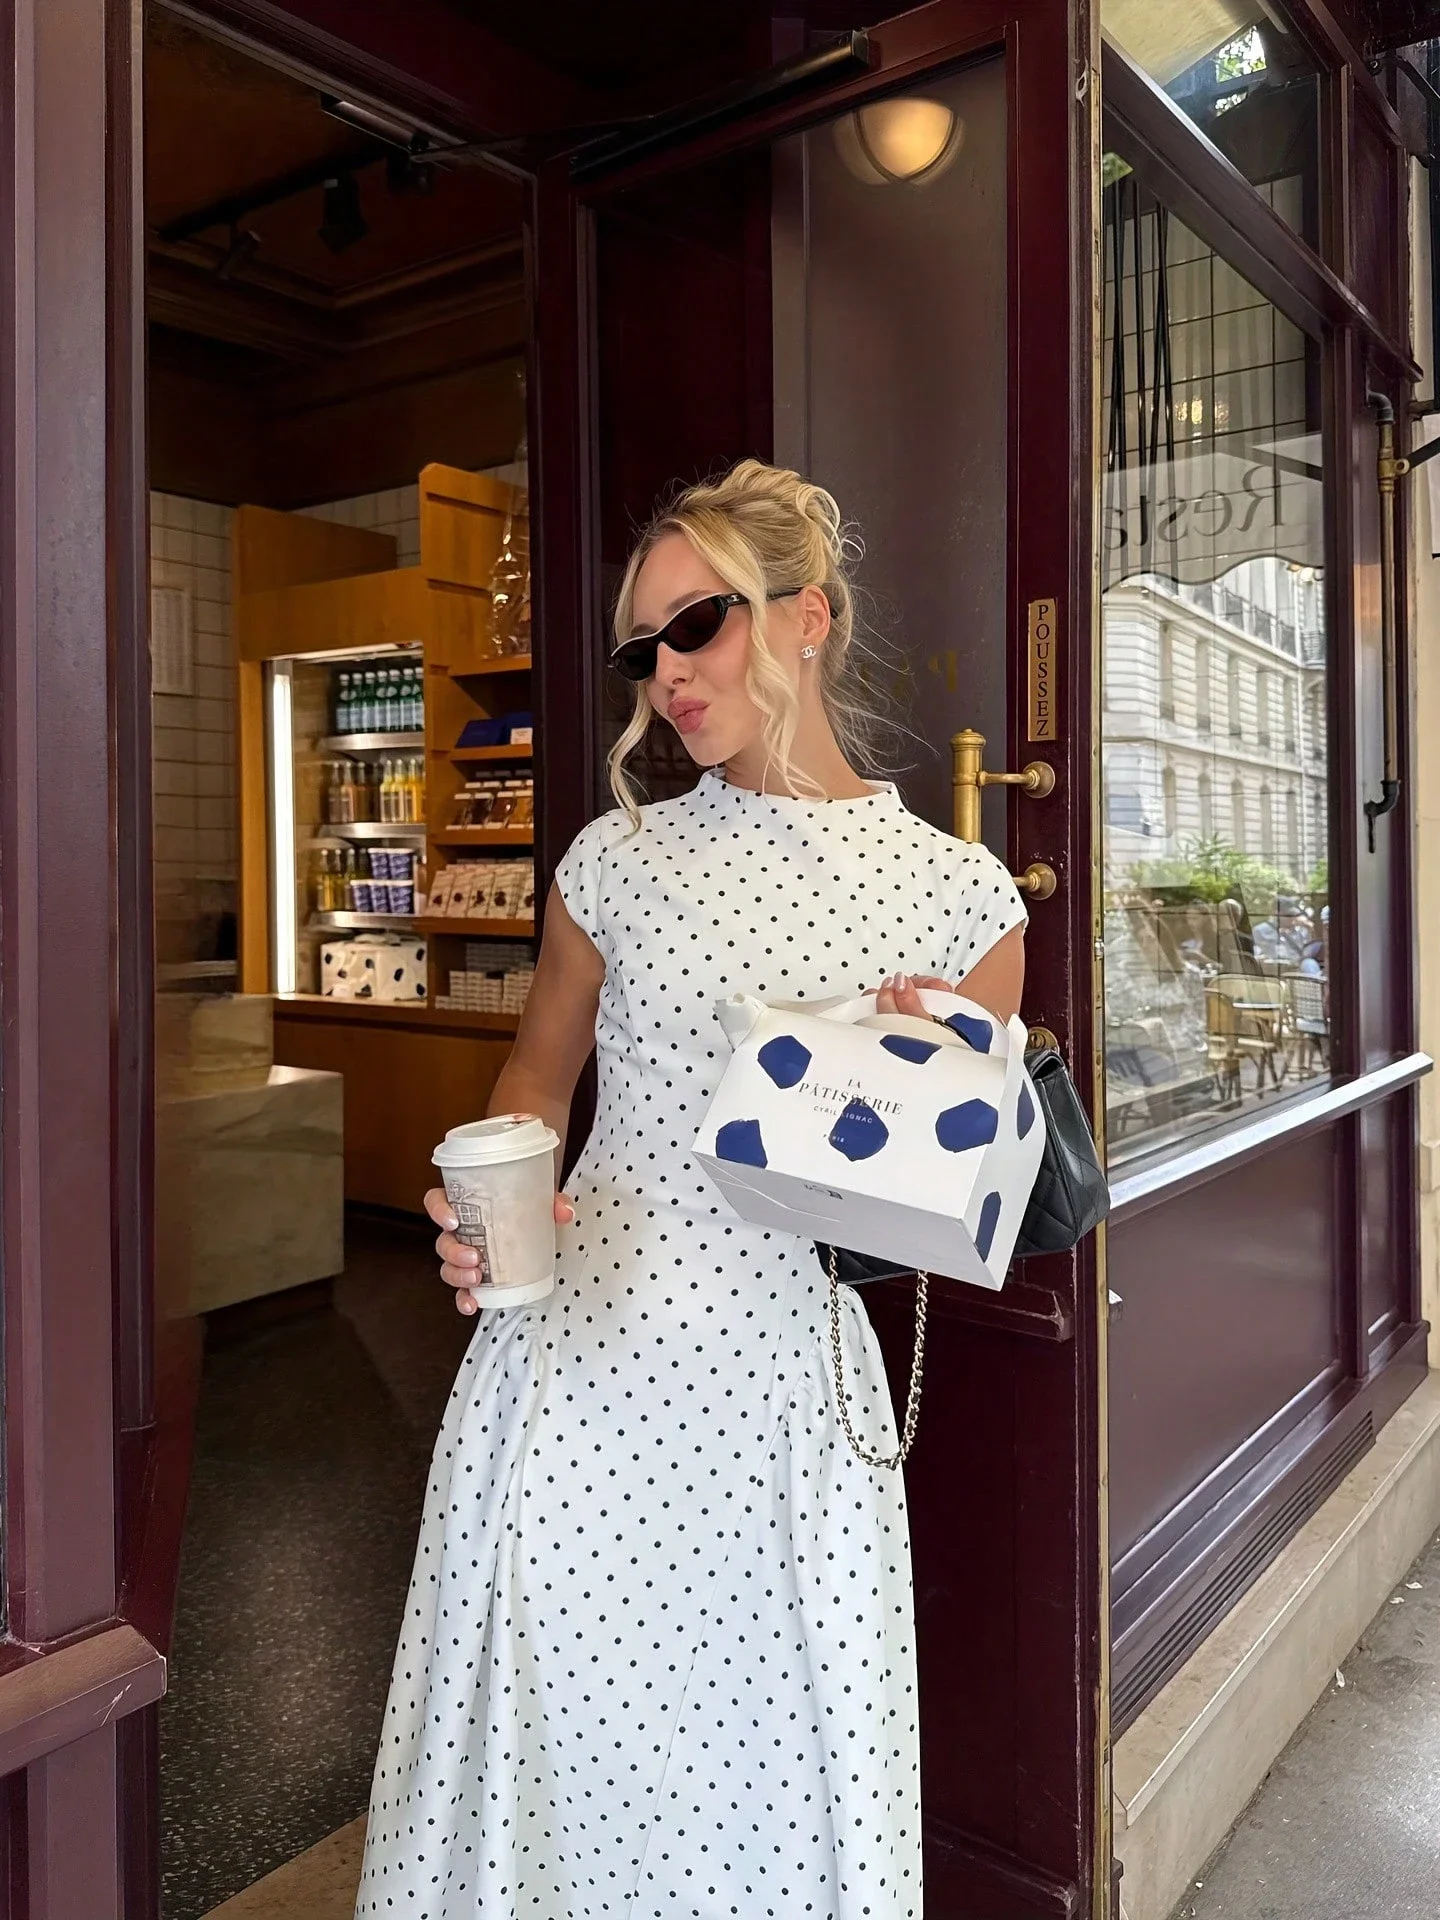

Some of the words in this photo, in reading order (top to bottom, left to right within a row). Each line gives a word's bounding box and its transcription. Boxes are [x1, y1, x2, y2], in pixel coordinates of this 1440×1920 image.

[1036, 604, 1050, 737] POUSSEZ
[848, 1079, 861, 1088] LA
[813, 1105, 837, 1116] CYRIL
[841, 1111, 873, 1124] IGNAC
